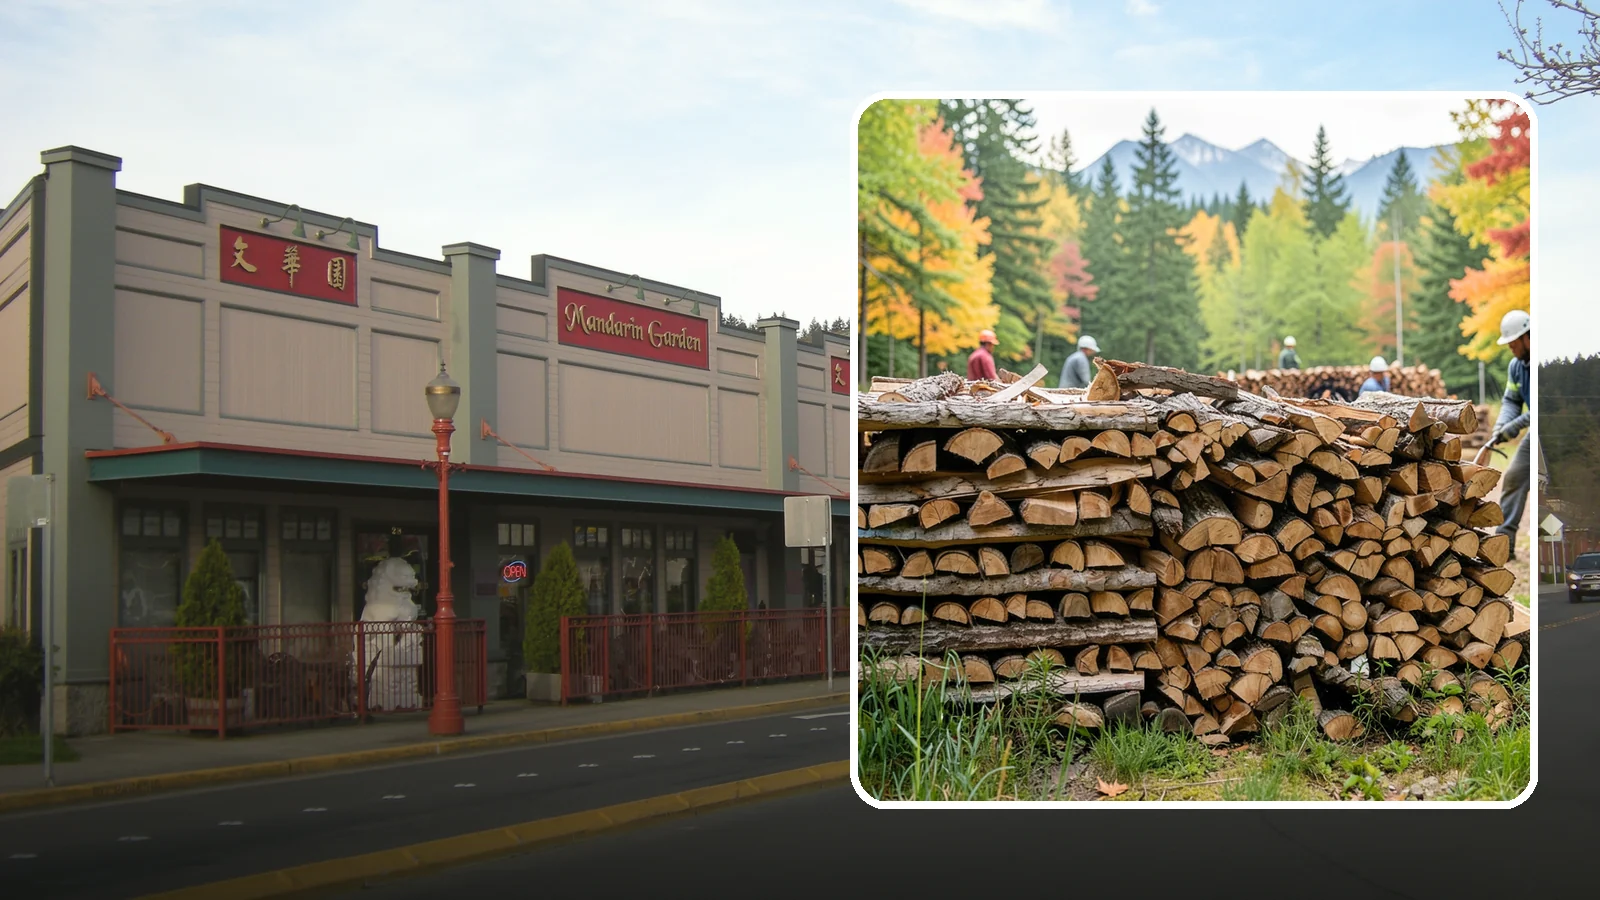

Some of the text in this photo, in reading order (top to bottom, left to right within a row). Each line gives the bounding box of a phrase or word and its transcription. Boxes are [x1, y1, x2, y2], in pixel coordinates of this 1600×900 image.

[231, 236, 346, 291] 文華園
[564, 302, 702, 352] Mandarin Garden
[504, 565, 526, 578] OPEN
